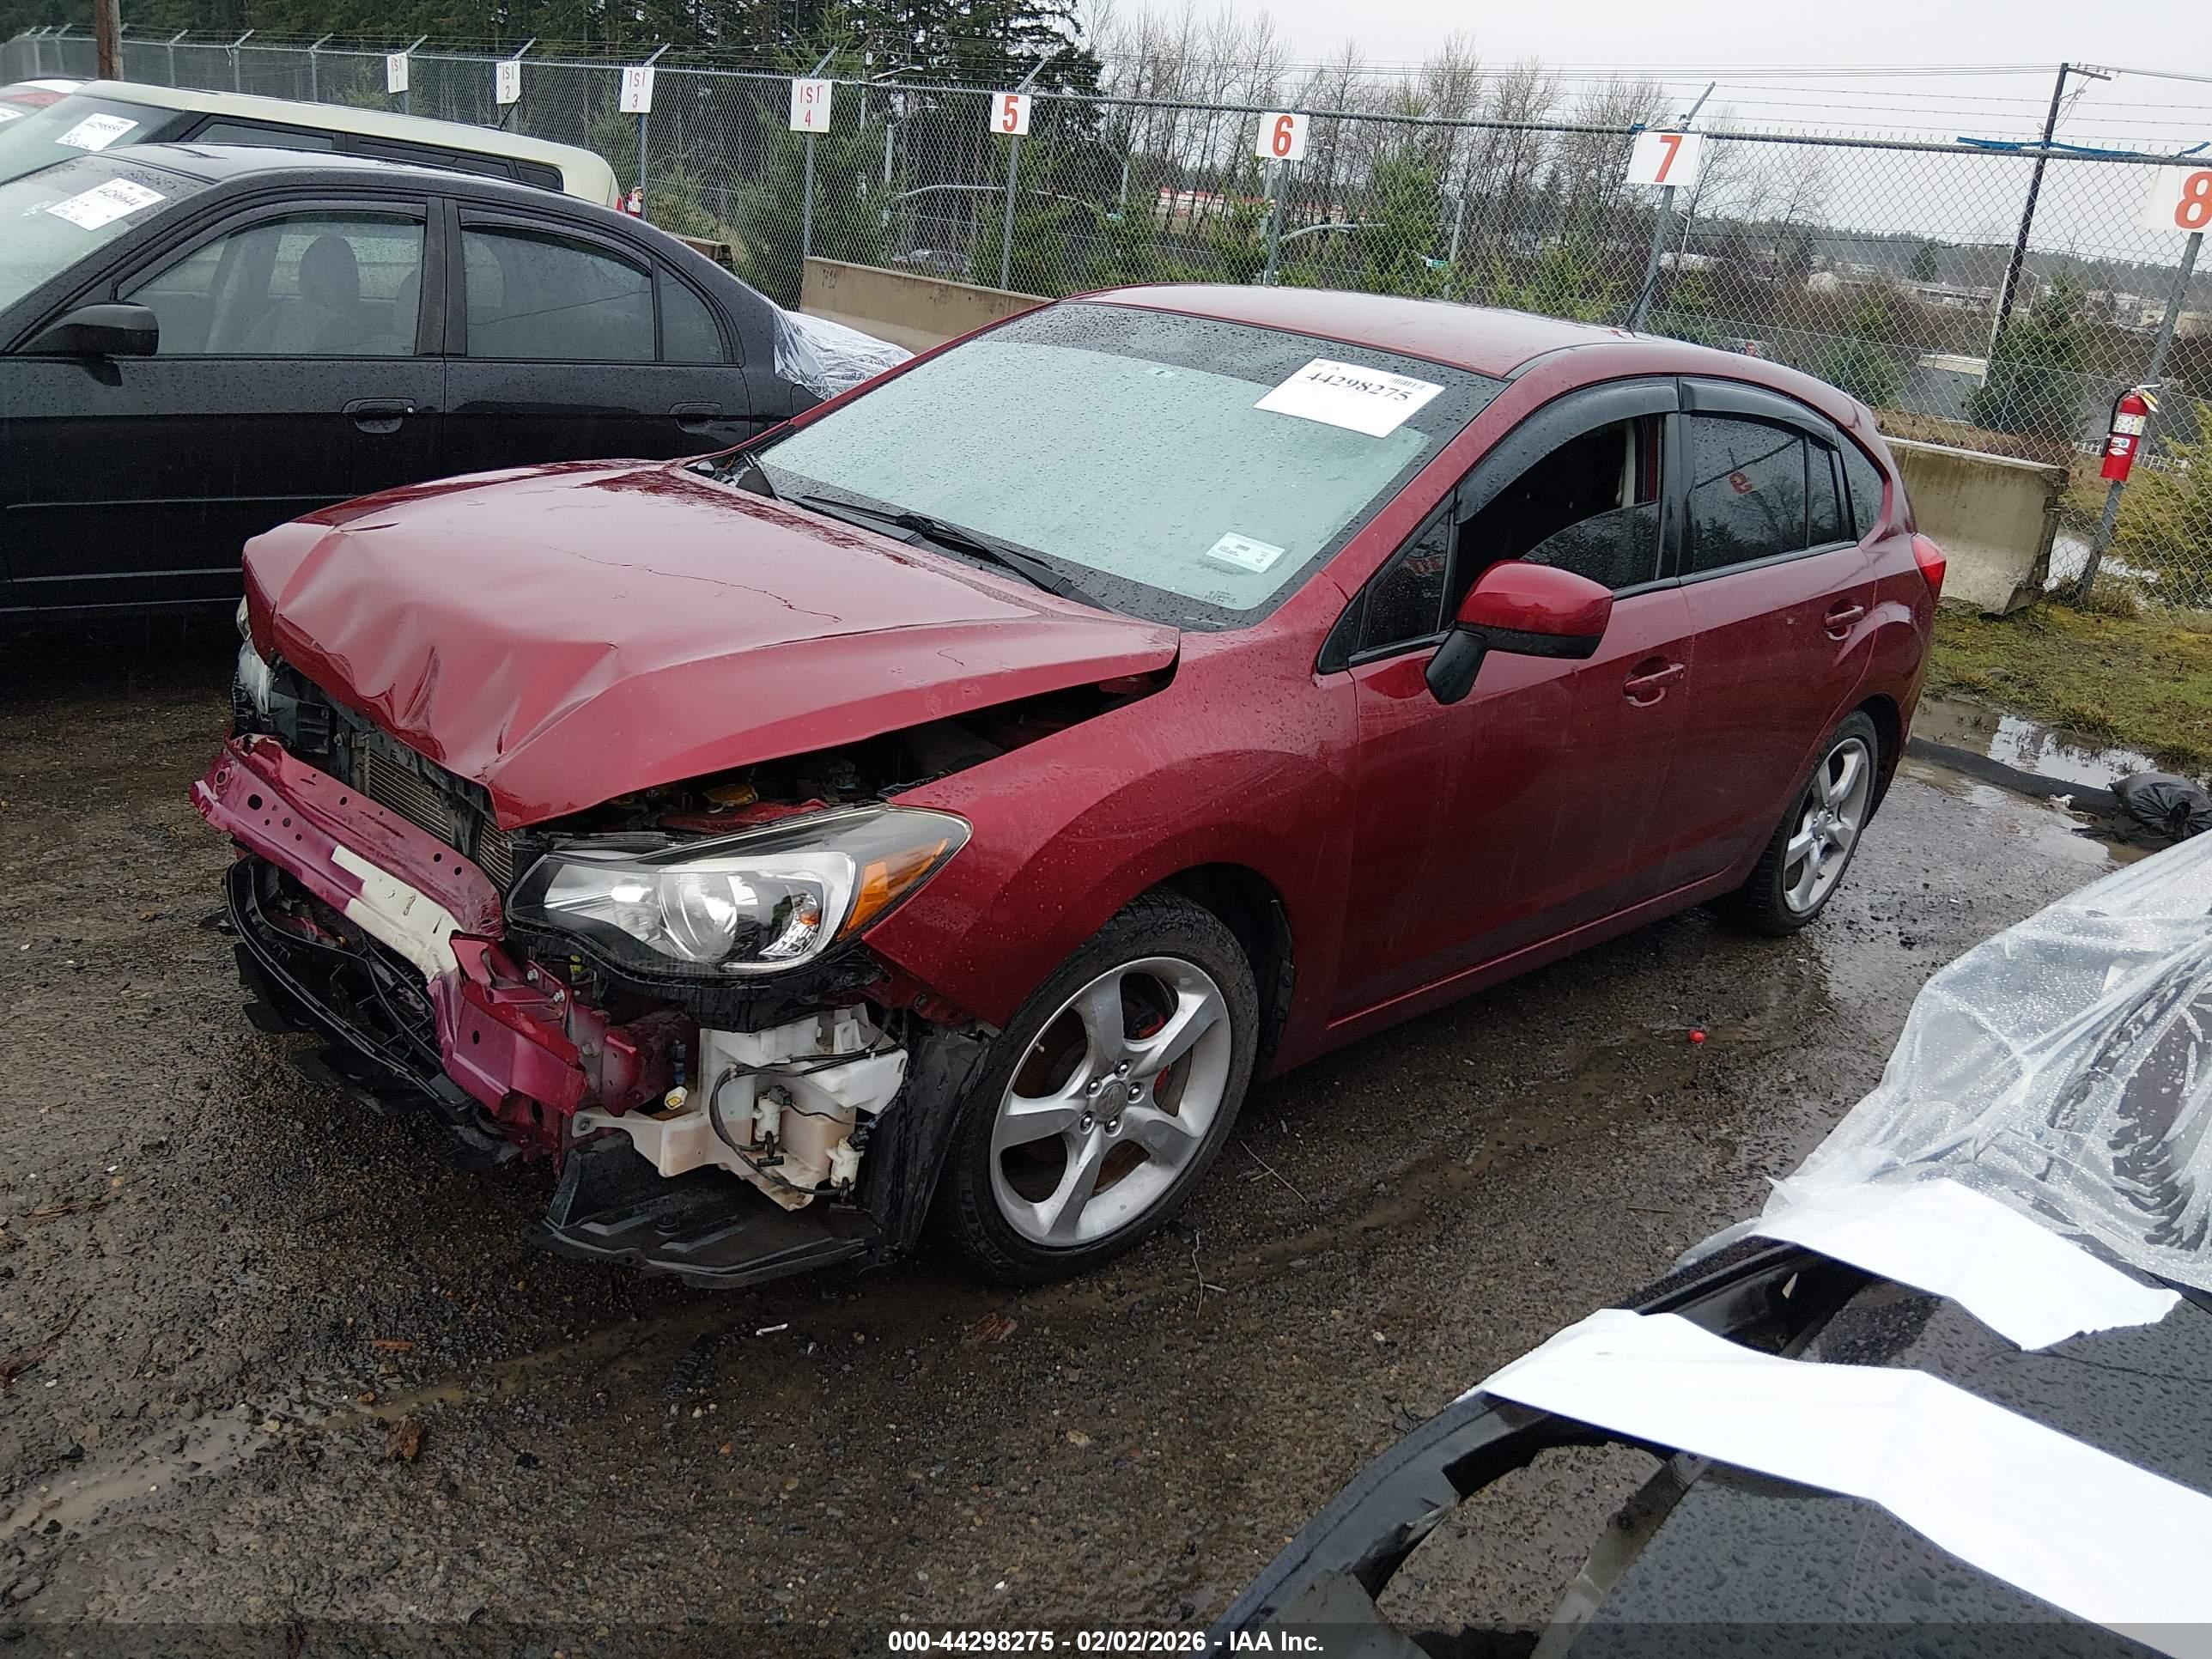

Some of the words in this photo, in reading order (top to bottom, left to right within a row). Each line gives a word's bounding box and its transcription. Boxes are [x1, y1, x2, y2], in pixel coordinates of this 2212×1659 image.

[505, 85, 510, 99] 2
[633, 94, 639, 108] 3
[805, 109, 811, 127] 4
[1002, 95, 1019, 132] 5
[1273, 115, 1293, 157] 6
[1654, 135, 1684, 183] 7
[2173, 170, 2212, 229] 8
[1306, 372, 1413, 401] 44298275
